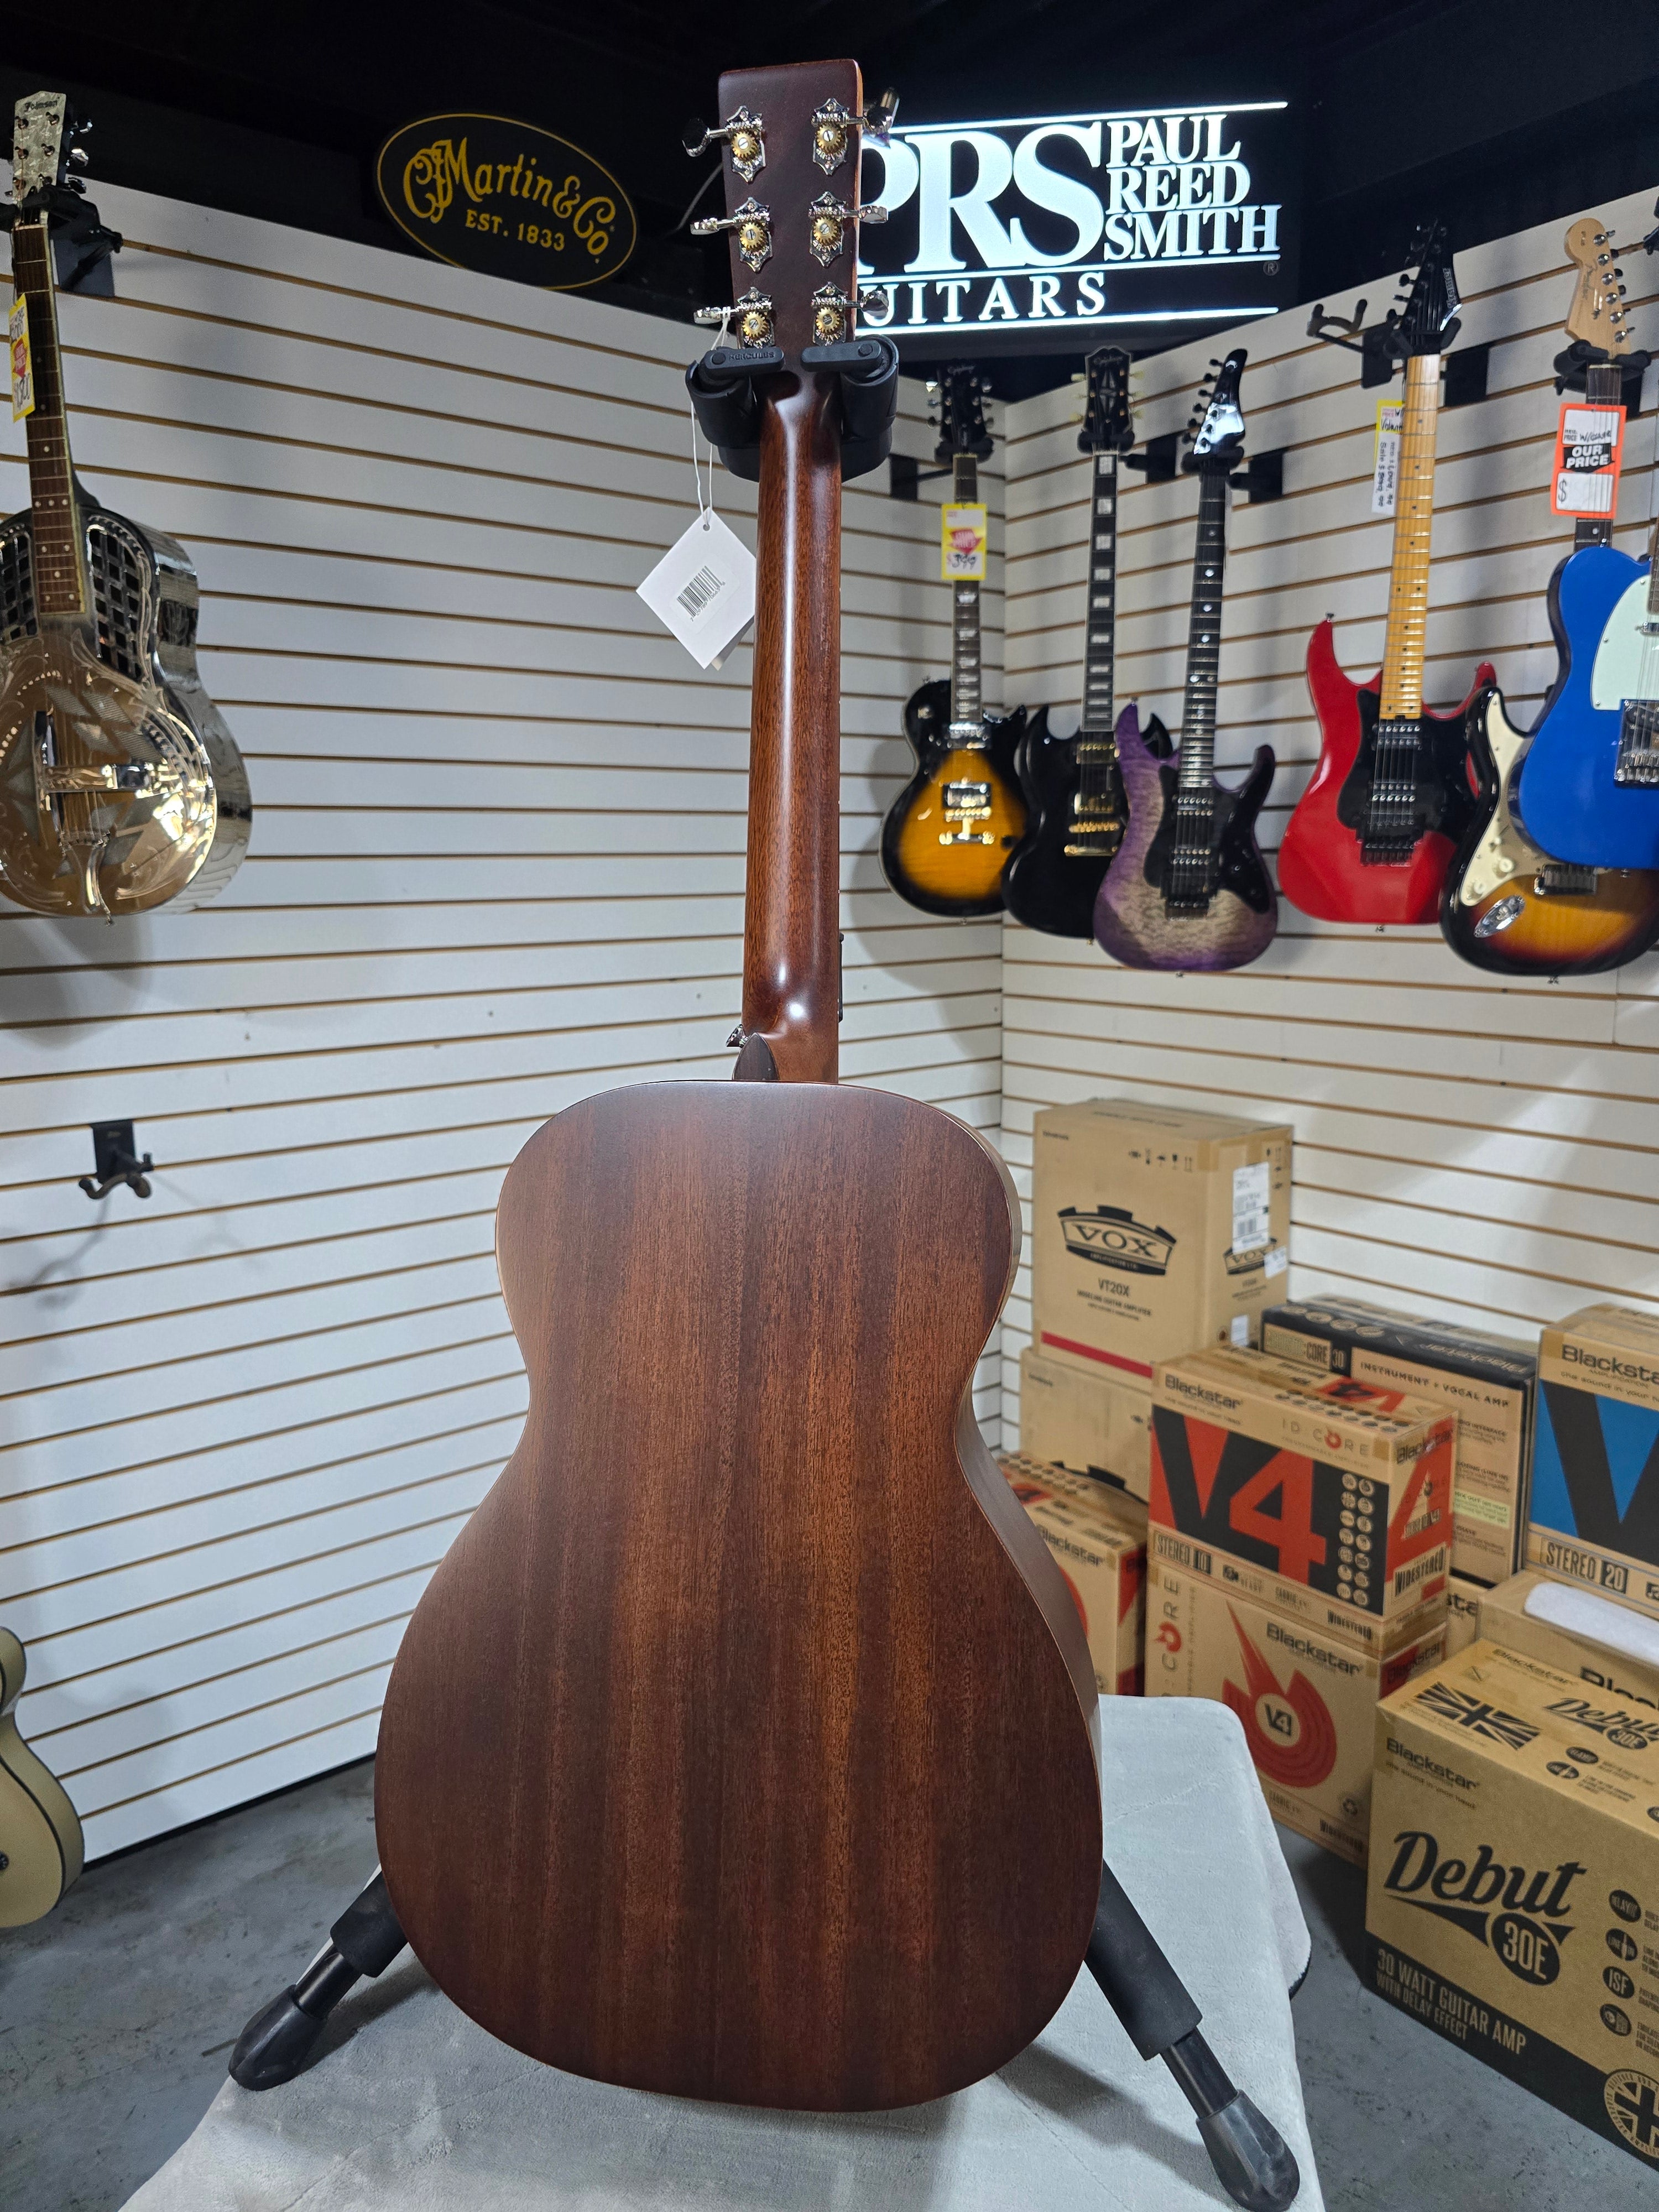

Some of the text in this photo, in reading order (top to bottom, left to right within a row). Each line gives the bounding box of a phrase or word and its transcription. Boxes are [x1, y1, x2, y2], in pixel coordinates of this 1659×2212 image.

[1107, 113, 1241, 168] PAUL
[1106, 160, 1251, 215] REED
[466, 210, 565, 251] EST. 1833
[1103, 204, 1282, 262] SMITH
[858, 270, 1105, 328] UITARS
[1566, 454, 1610, 469] PRICE
[1572, 445, 1604, 457] OUR
[1558, 478, 1567, 503] $
[1072, 1222, 1157, 1259] VOX
[1098, 1278, 1130, 1297] VT20X
[1360, 1361, 1430, 1387] INSTRUMENT
[1442, 1383, 1480, 1400] VOCAL
[1561, 1343, 1659, 1385] Blacksta
[1165, 1373, 1240, 1410] Blackstar
[1157, 1534, 1190, 1566] STEREO
[1394, 1546, 1447, 1598] WIDESTEREO
[1546, 1541, 1625, 1592] STEREO 20
[1266, 1620, 1360, 1677] Blackstar
[1543, 1697, 1659, 1735] Debu
[1386, 1736, 1478, 1790] Blackstar
[1384, 1830, 1588, 1917] Debut
[1503, 1921, 1548, 1981] 30E
[1378, 1948, 1527, 2055] 30 WATT GUITAR AMP
[1609, 1968, 1629, 1995] ISF
[1402, 1987, 1432, 2017] DELAY
[1434, 2007, 1468, 2041] EFFECT
